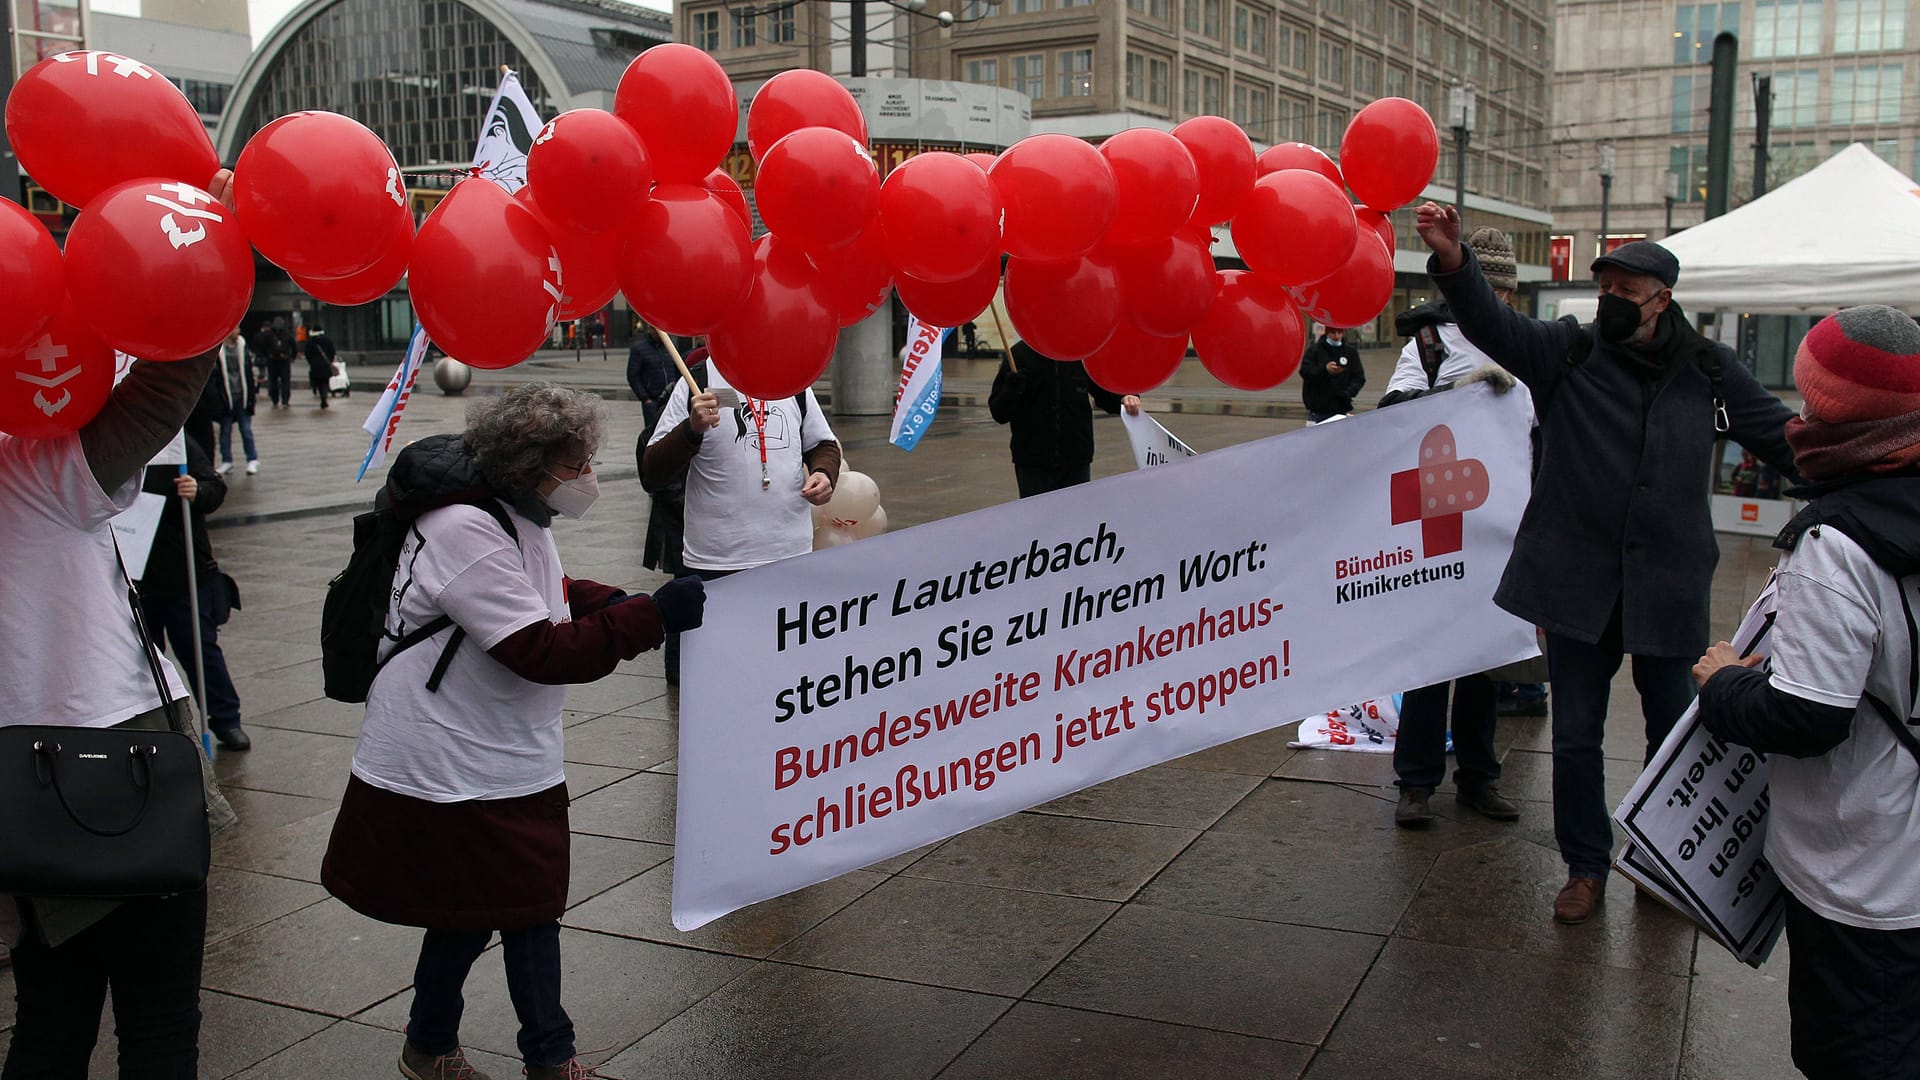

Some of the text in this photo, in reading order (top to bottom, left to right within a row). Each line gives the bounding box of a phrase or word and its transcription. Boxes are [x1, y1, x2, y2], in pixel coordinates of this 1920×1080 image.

[778, 523, 1124, 652] Herr Lauterbach,
[1336, 546, 1413, 579] Bündnis
[1337, 560, 1464, 604] Klinikrettung
[775, 541, 1267, 722] stehen Sie zu Ihrem Wort:
[775, 599, 1283, 790] Bundesweite Krankenhaus-
[770, 640, 1289, 855] schließungen jetzt stoppen!
[1679, 797, 1730, 860] Ihre
